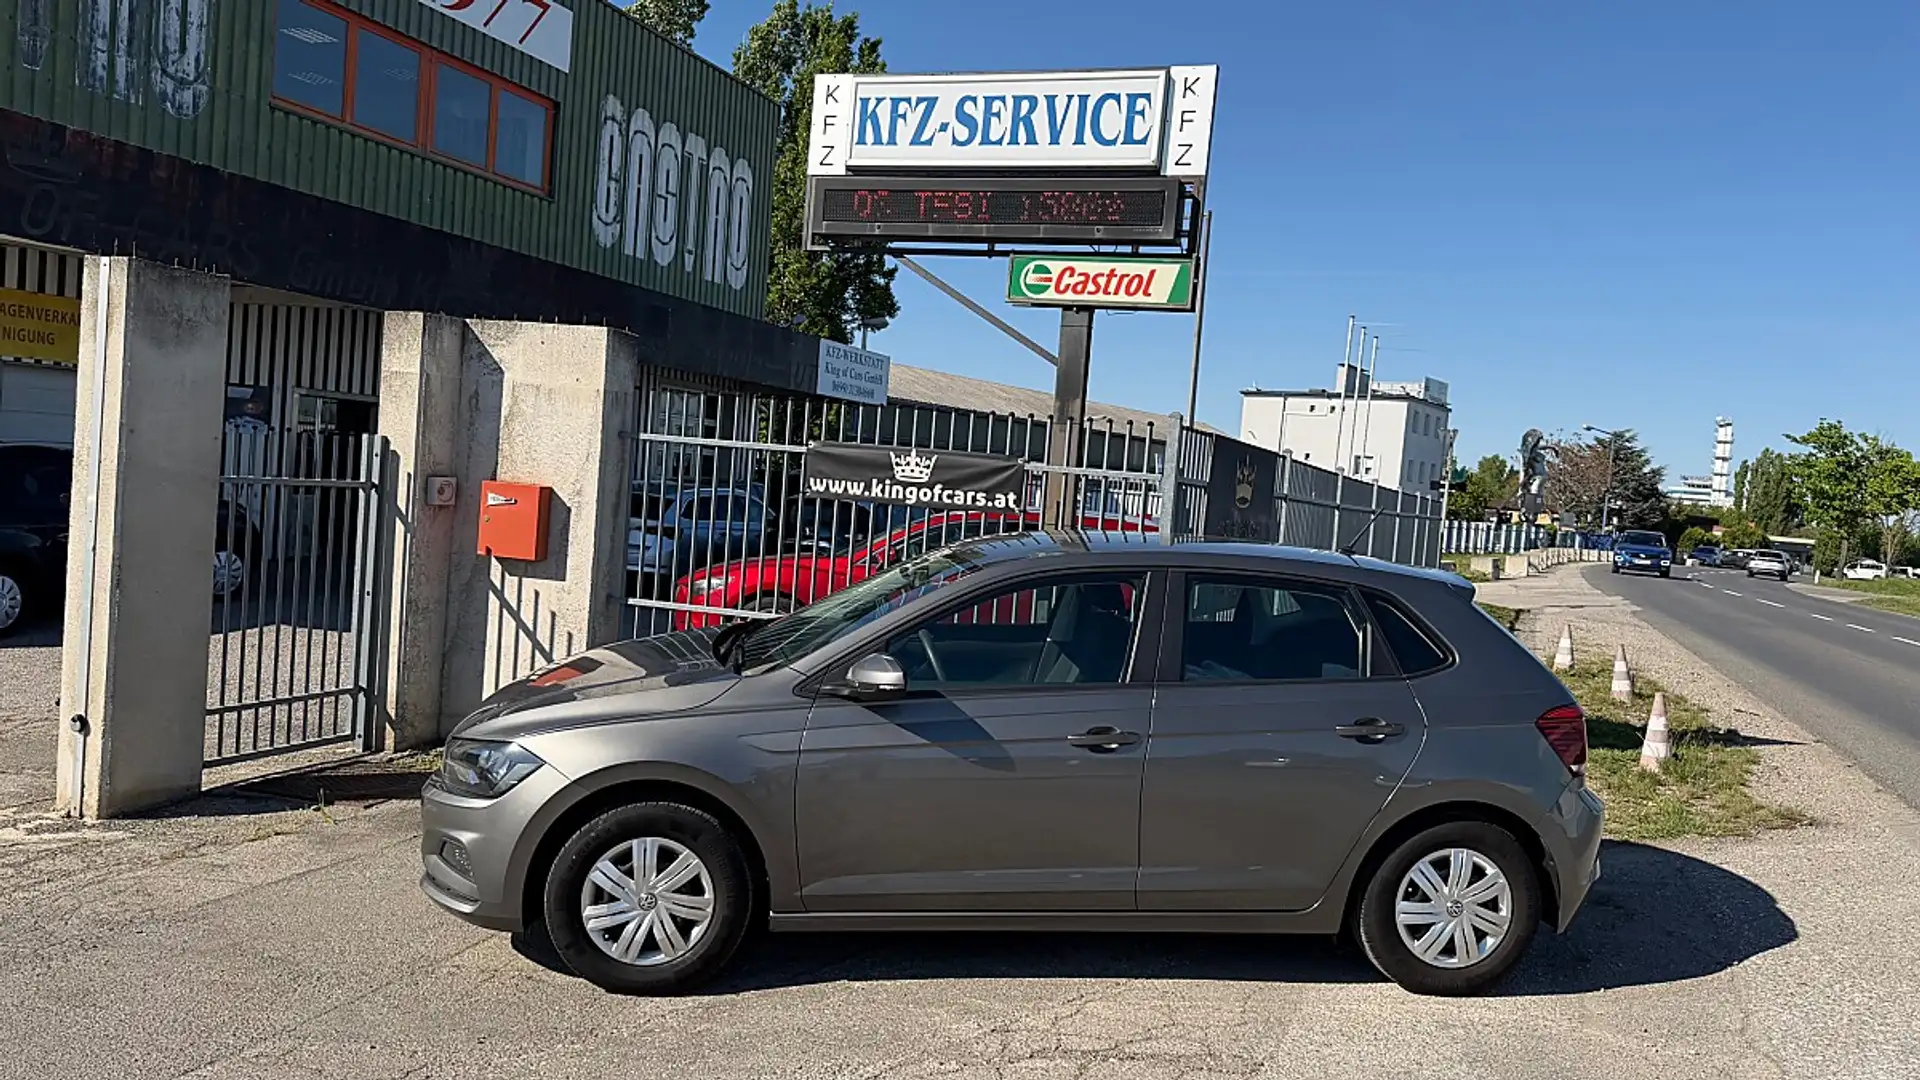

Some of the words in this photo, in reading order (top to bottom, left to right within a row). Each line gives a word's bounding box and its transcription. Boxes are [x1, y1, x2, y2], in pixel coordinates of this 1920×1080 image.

[855, 93, 1153, 148] KFZ-SERVICE
[1053, 266, 1157, 298] Castrol
[809, 477, 1017, 509] www.kingofcars.at
